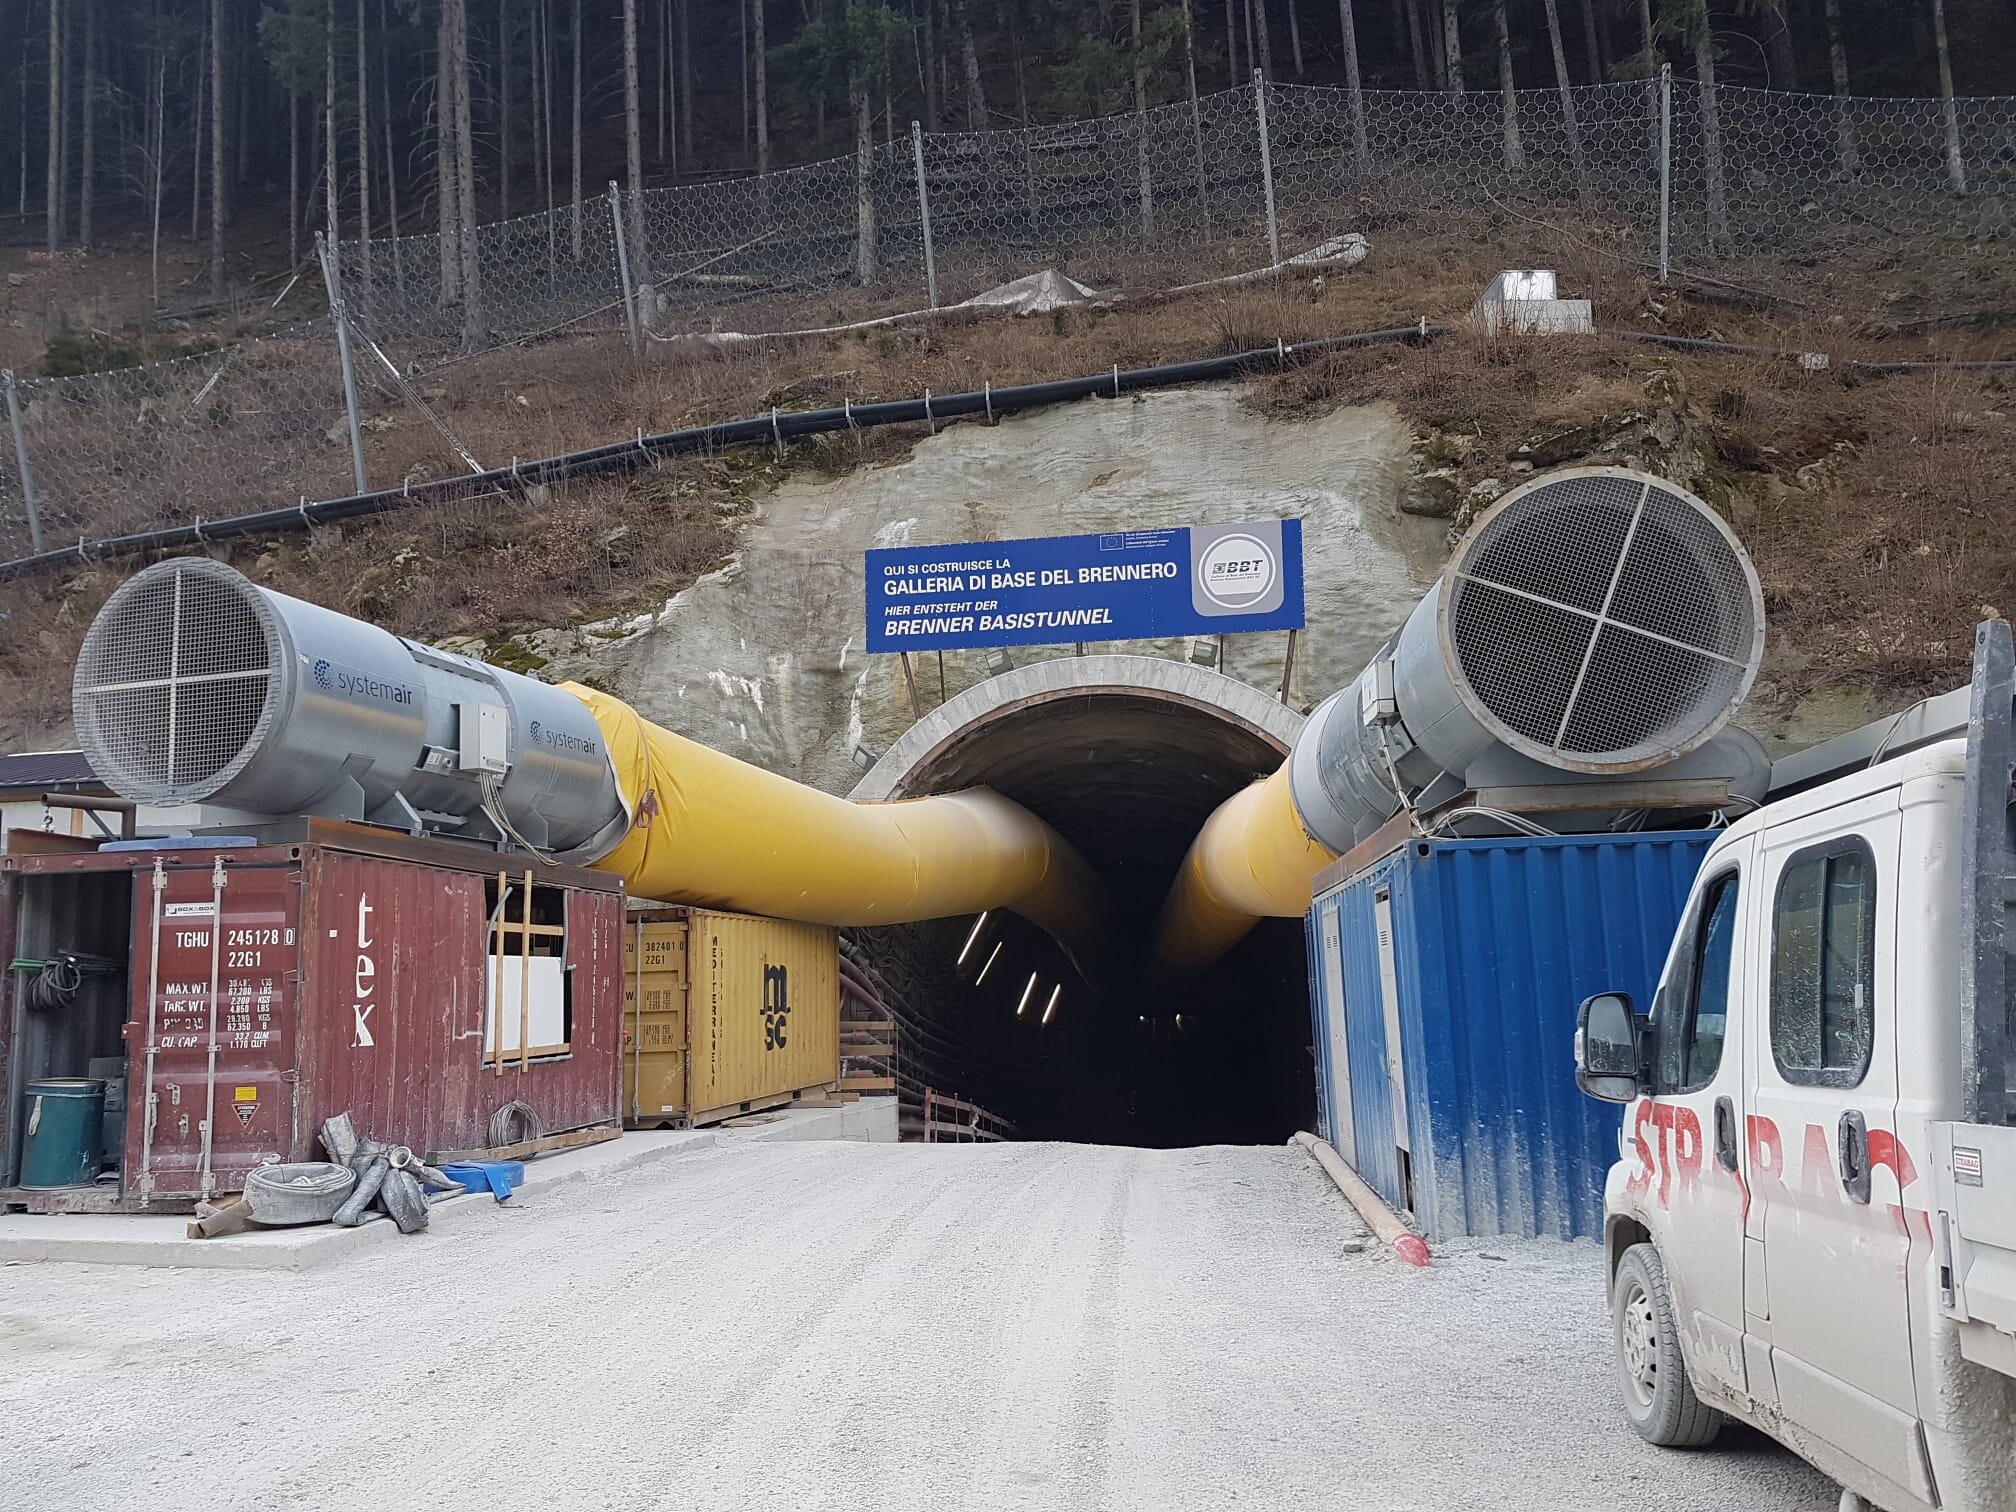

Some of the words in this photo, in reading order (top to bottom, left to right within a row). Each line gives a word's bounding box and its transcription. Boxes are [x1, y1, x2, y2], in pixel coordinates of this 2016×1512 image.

[884, 565, 905, 576] QUI
[907, 564, 919, 575] SI
[921, 559, 993, 574] COSTRUISCE
[996, 558, 1011, 569] LA
[1226, 559, 1264, 574] BBT
[884, 576, 965, 596] GALLERIA
[969, 574, 986, 591] DI
[991, 571, 1036, 589] BASE
[1040, 569, 1074, 586] DEL
[1078, 561, 1178, 584] BRENNERO
[884, 605, 911, 617] HIER
[913, 601, 973, 615] ENTSTEHT
[974, 600, 998, 611] DER
[884, 616, 975, 637] BRENNER
[978, 608, 1113, 631] BASISTUNNEL
[338, 672, 412, 705] systemair
[546, 730, 596, 756] systemair
[176, 931, 209, 948] TGHU
[227, 929, 279, 946] 245128
[285, 928, 294, 945] 0
[227, 951, 261, 967] 22G1
[645, 955, 665, 965] 22G1
[259, 986, 273, 995] LBS
[257, 1004, 270, 1013] LBS
